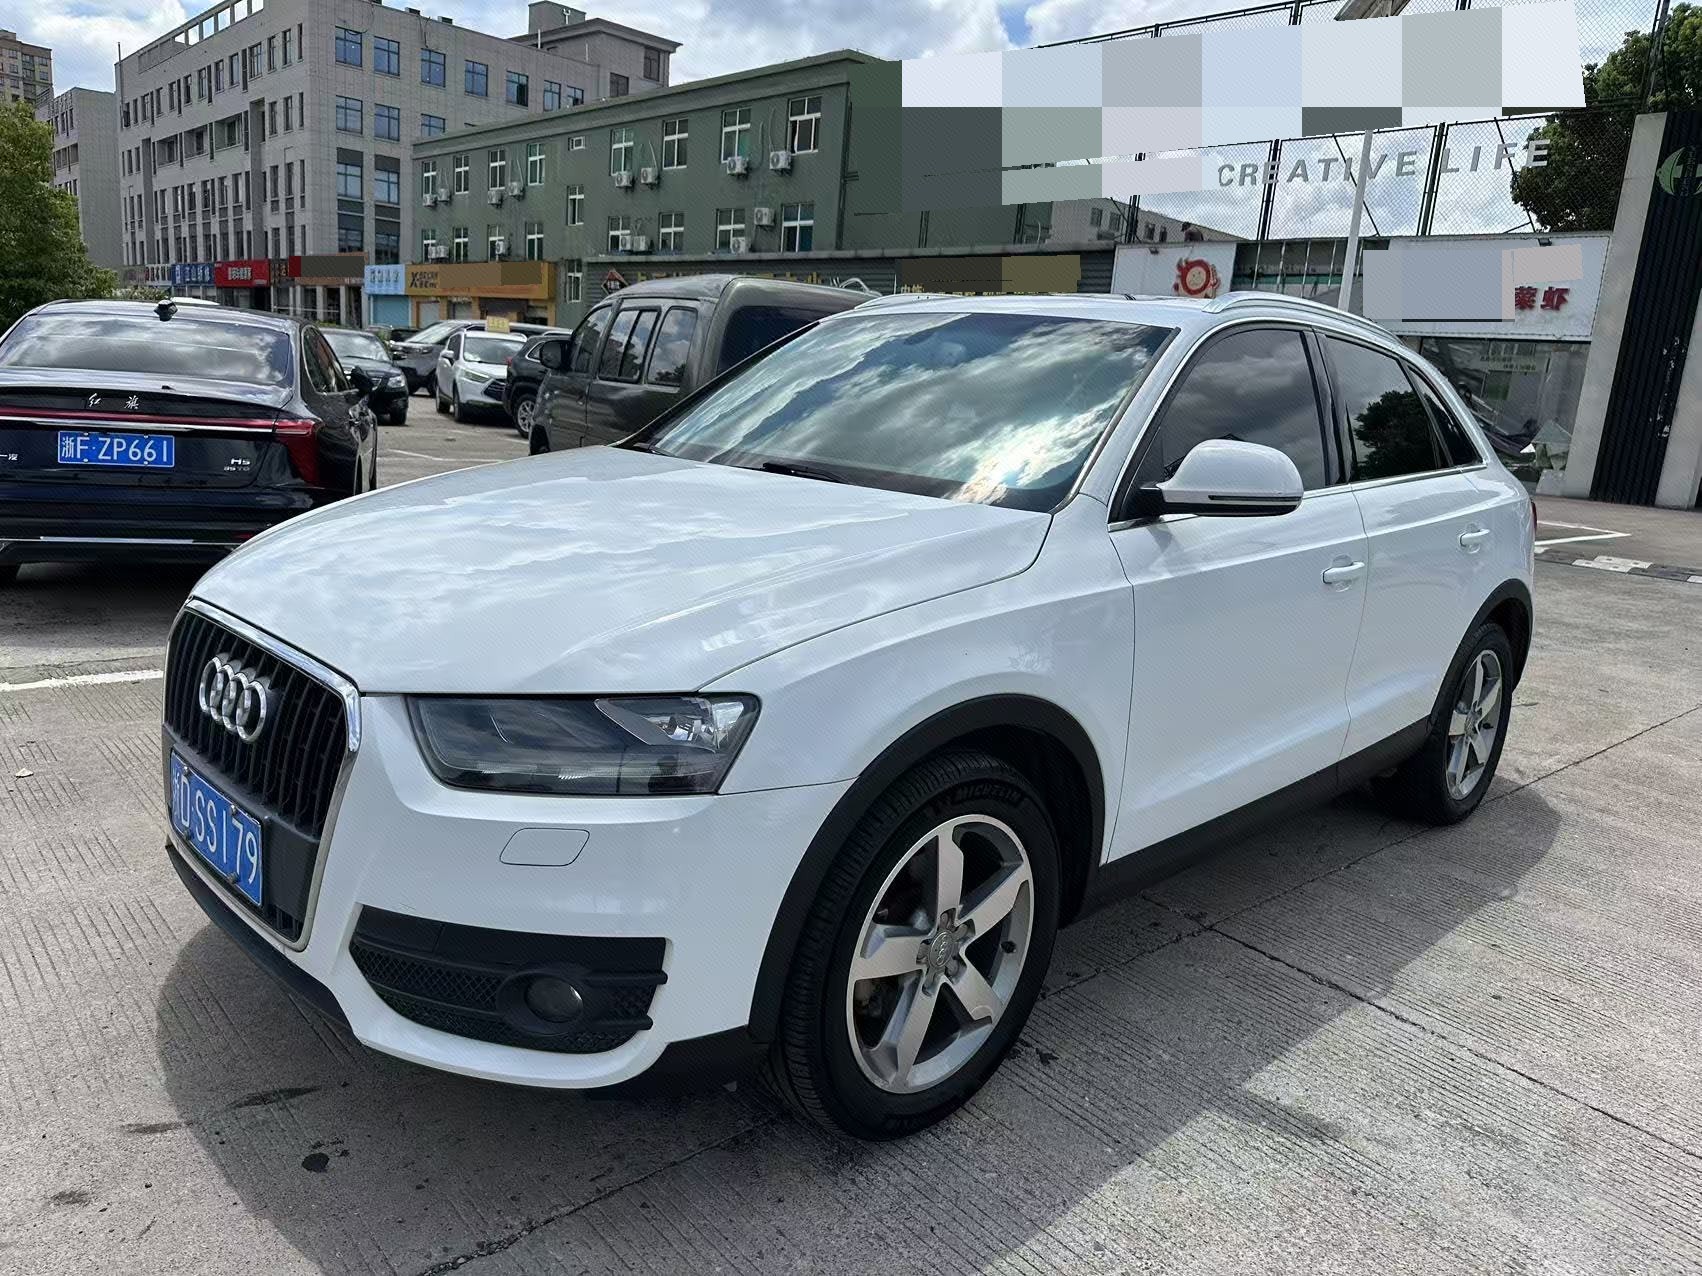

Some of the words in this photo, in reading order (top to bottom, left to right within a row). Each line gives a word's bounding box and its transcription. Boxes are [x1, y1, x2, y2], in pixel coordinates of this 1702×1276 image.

[1217, 150, 1419, 187] CREATIVE
[1440, 138, 1551, 174] LIFE
[87, 392, 141, 410] 红旗
